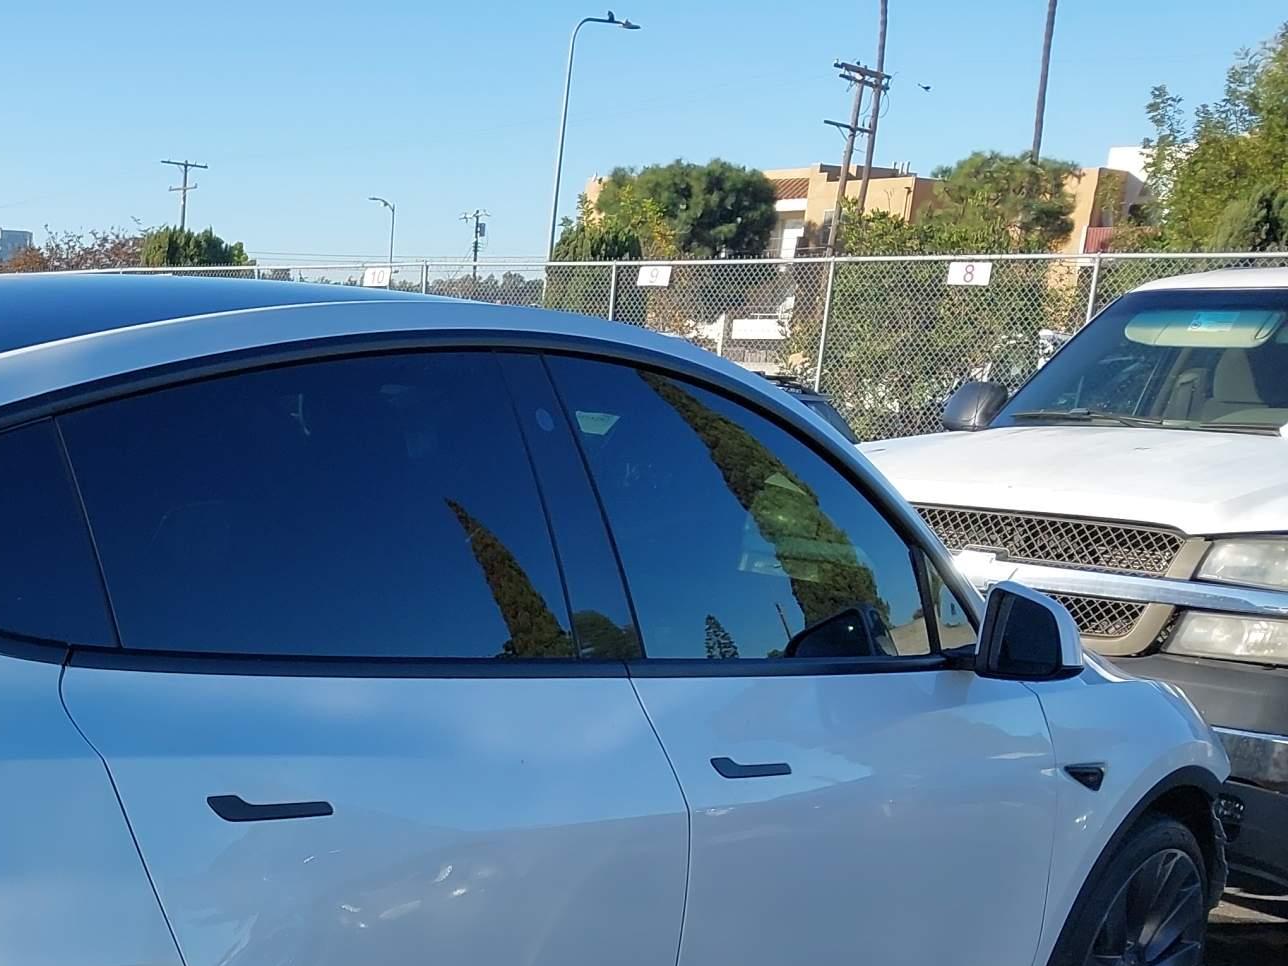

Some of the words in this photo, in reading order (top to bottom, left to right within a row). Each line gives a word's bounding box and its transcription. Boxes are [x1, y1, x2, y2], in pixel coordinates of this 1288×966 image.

[371, 269, 385, 284] 10
[648, 267, 659, 284] 9
[963, 264, 975, 283] 8
